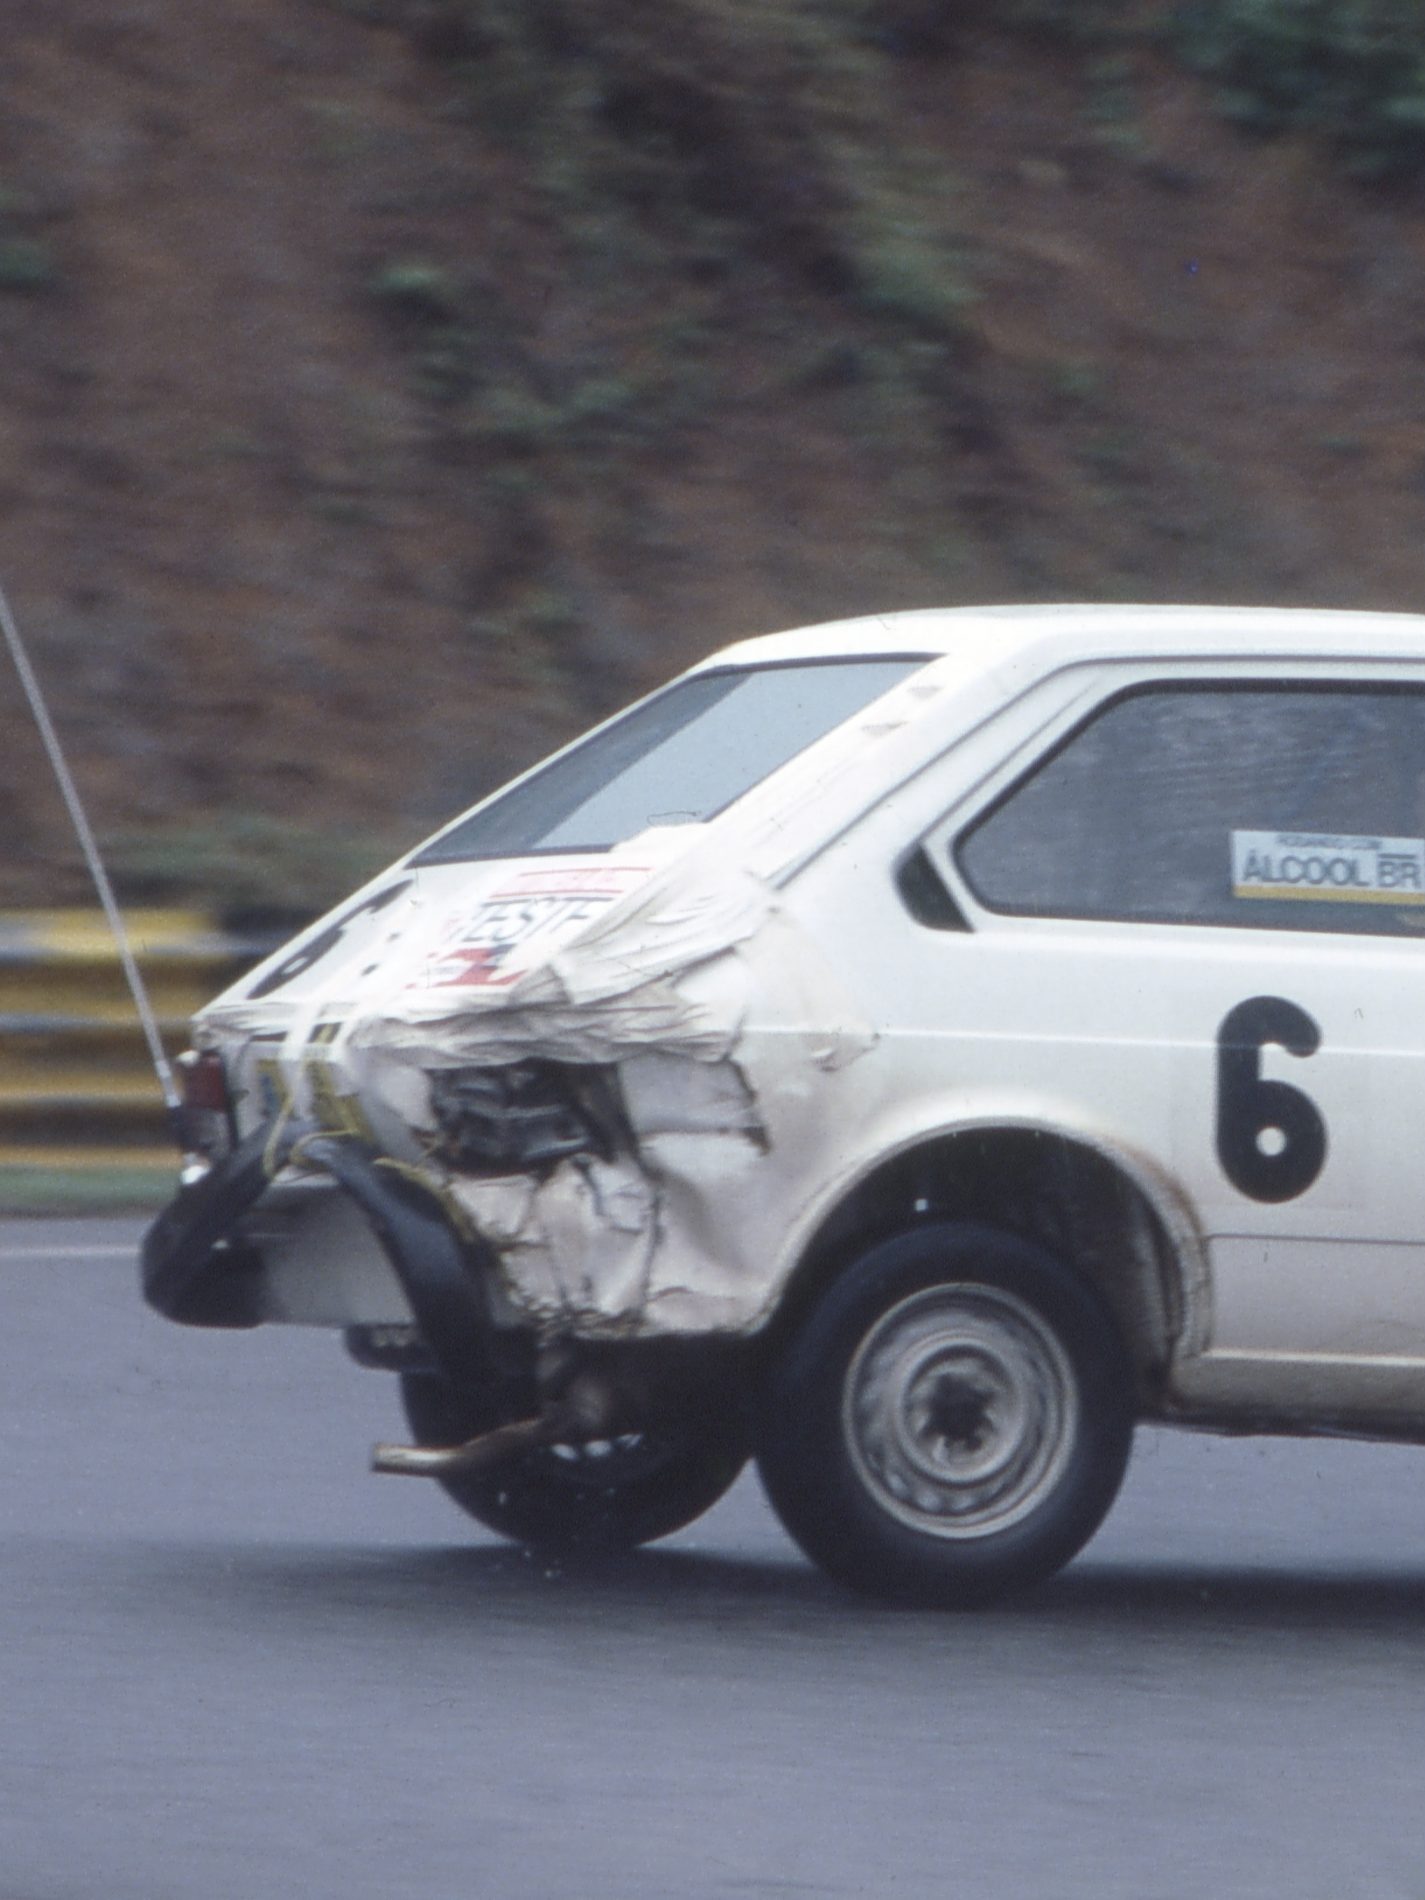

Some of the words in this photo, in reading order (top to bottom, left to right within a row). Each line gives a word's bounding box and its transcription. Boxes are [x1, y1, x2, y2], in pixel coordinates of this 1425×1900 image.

[1377, 860, 1421, 889] BR
[245, 878, 413, 1000] 6
[1216, 995, 1328, 1204] 6
